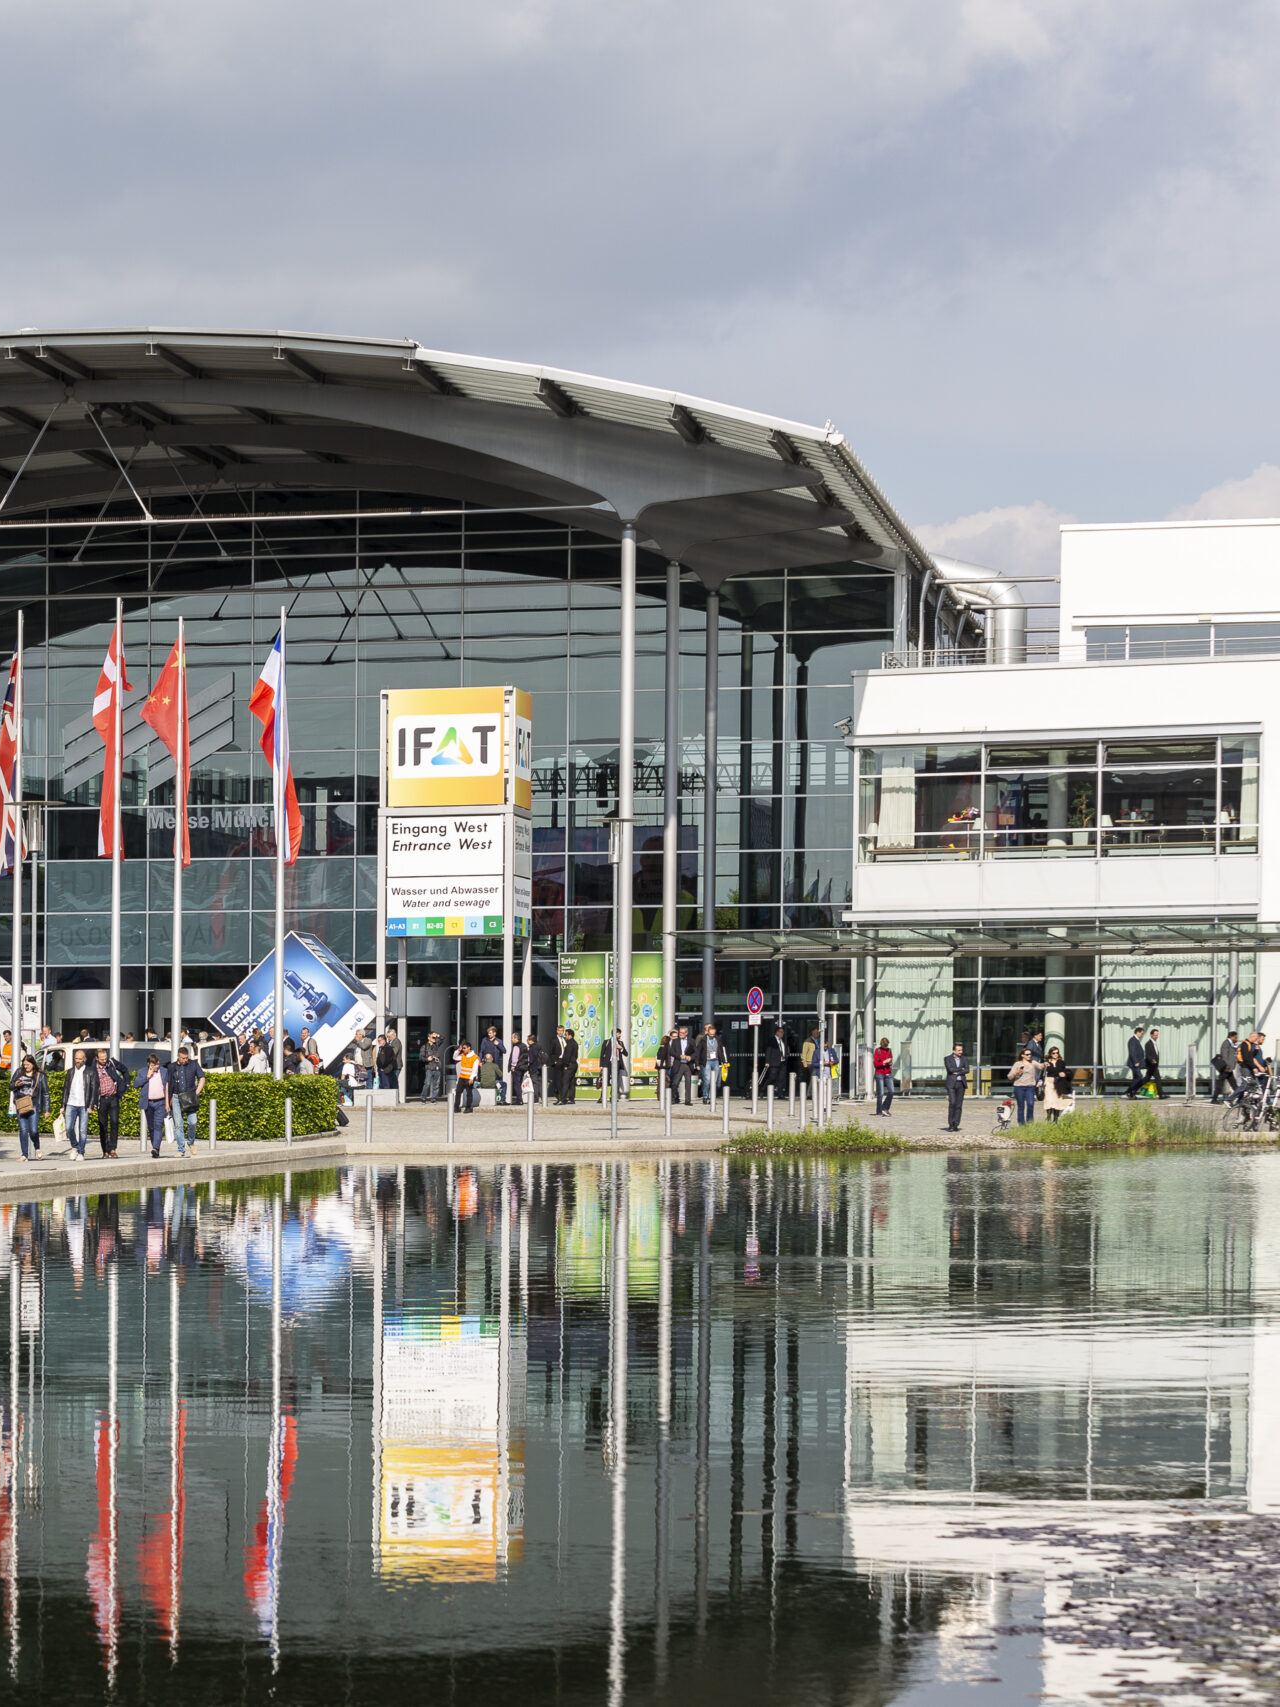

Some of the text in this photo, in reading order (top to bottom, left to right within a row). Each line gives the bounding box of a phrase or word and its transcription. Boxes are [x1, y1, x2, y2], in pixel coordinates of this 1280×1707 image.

[398, 725, 496, 766] IFAT
[148, 809, 305, 829] Mese Münc
[391, 821, 488, 837] Eingang West
[392, 838, 493, 851] Entrance West
[391, 886, 499, 896] Wasser und Abwasser
[402, 899, 491, 908] Water and sewage
[560, 957, 578, 966] Turkey
[221, 992, 250, 1022] COMES
[257, 1003, 275, 1024] WIT
[226, 1005, 251, 1029] WITH
